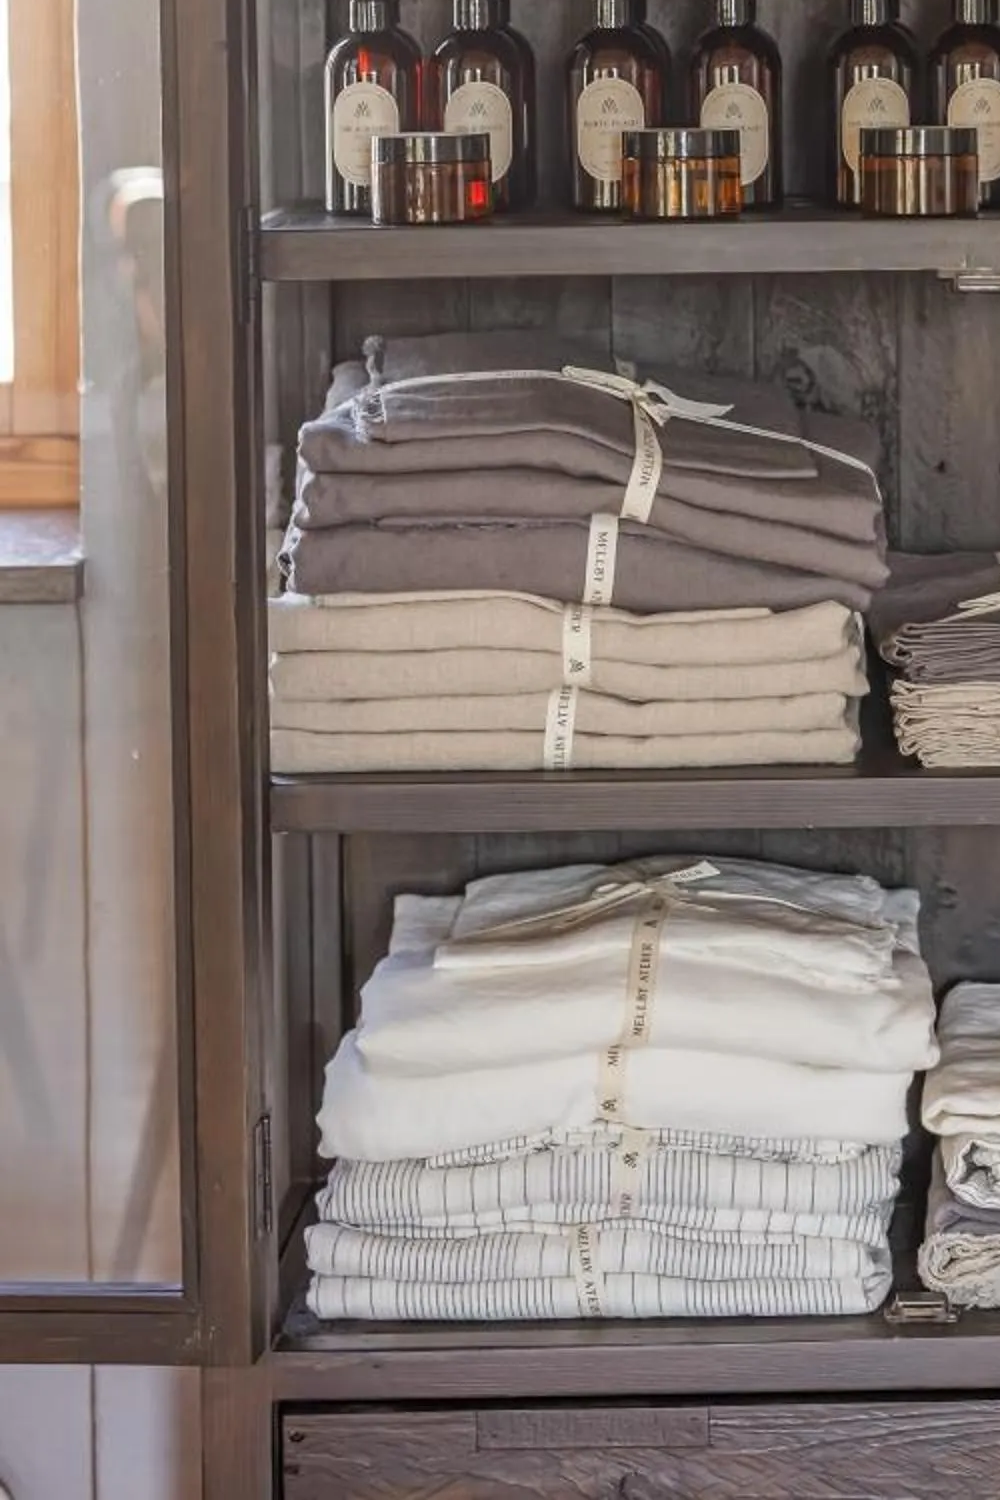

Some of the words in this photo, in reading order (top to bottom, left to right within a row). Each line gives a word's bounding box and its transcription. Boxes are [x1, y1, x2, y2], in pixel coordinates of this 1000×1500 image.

[593, 531, 609, 582] MELLBY
[640, 942, 654, 984] ATELIER
[632, 987, 649, 1037] MELLBY
